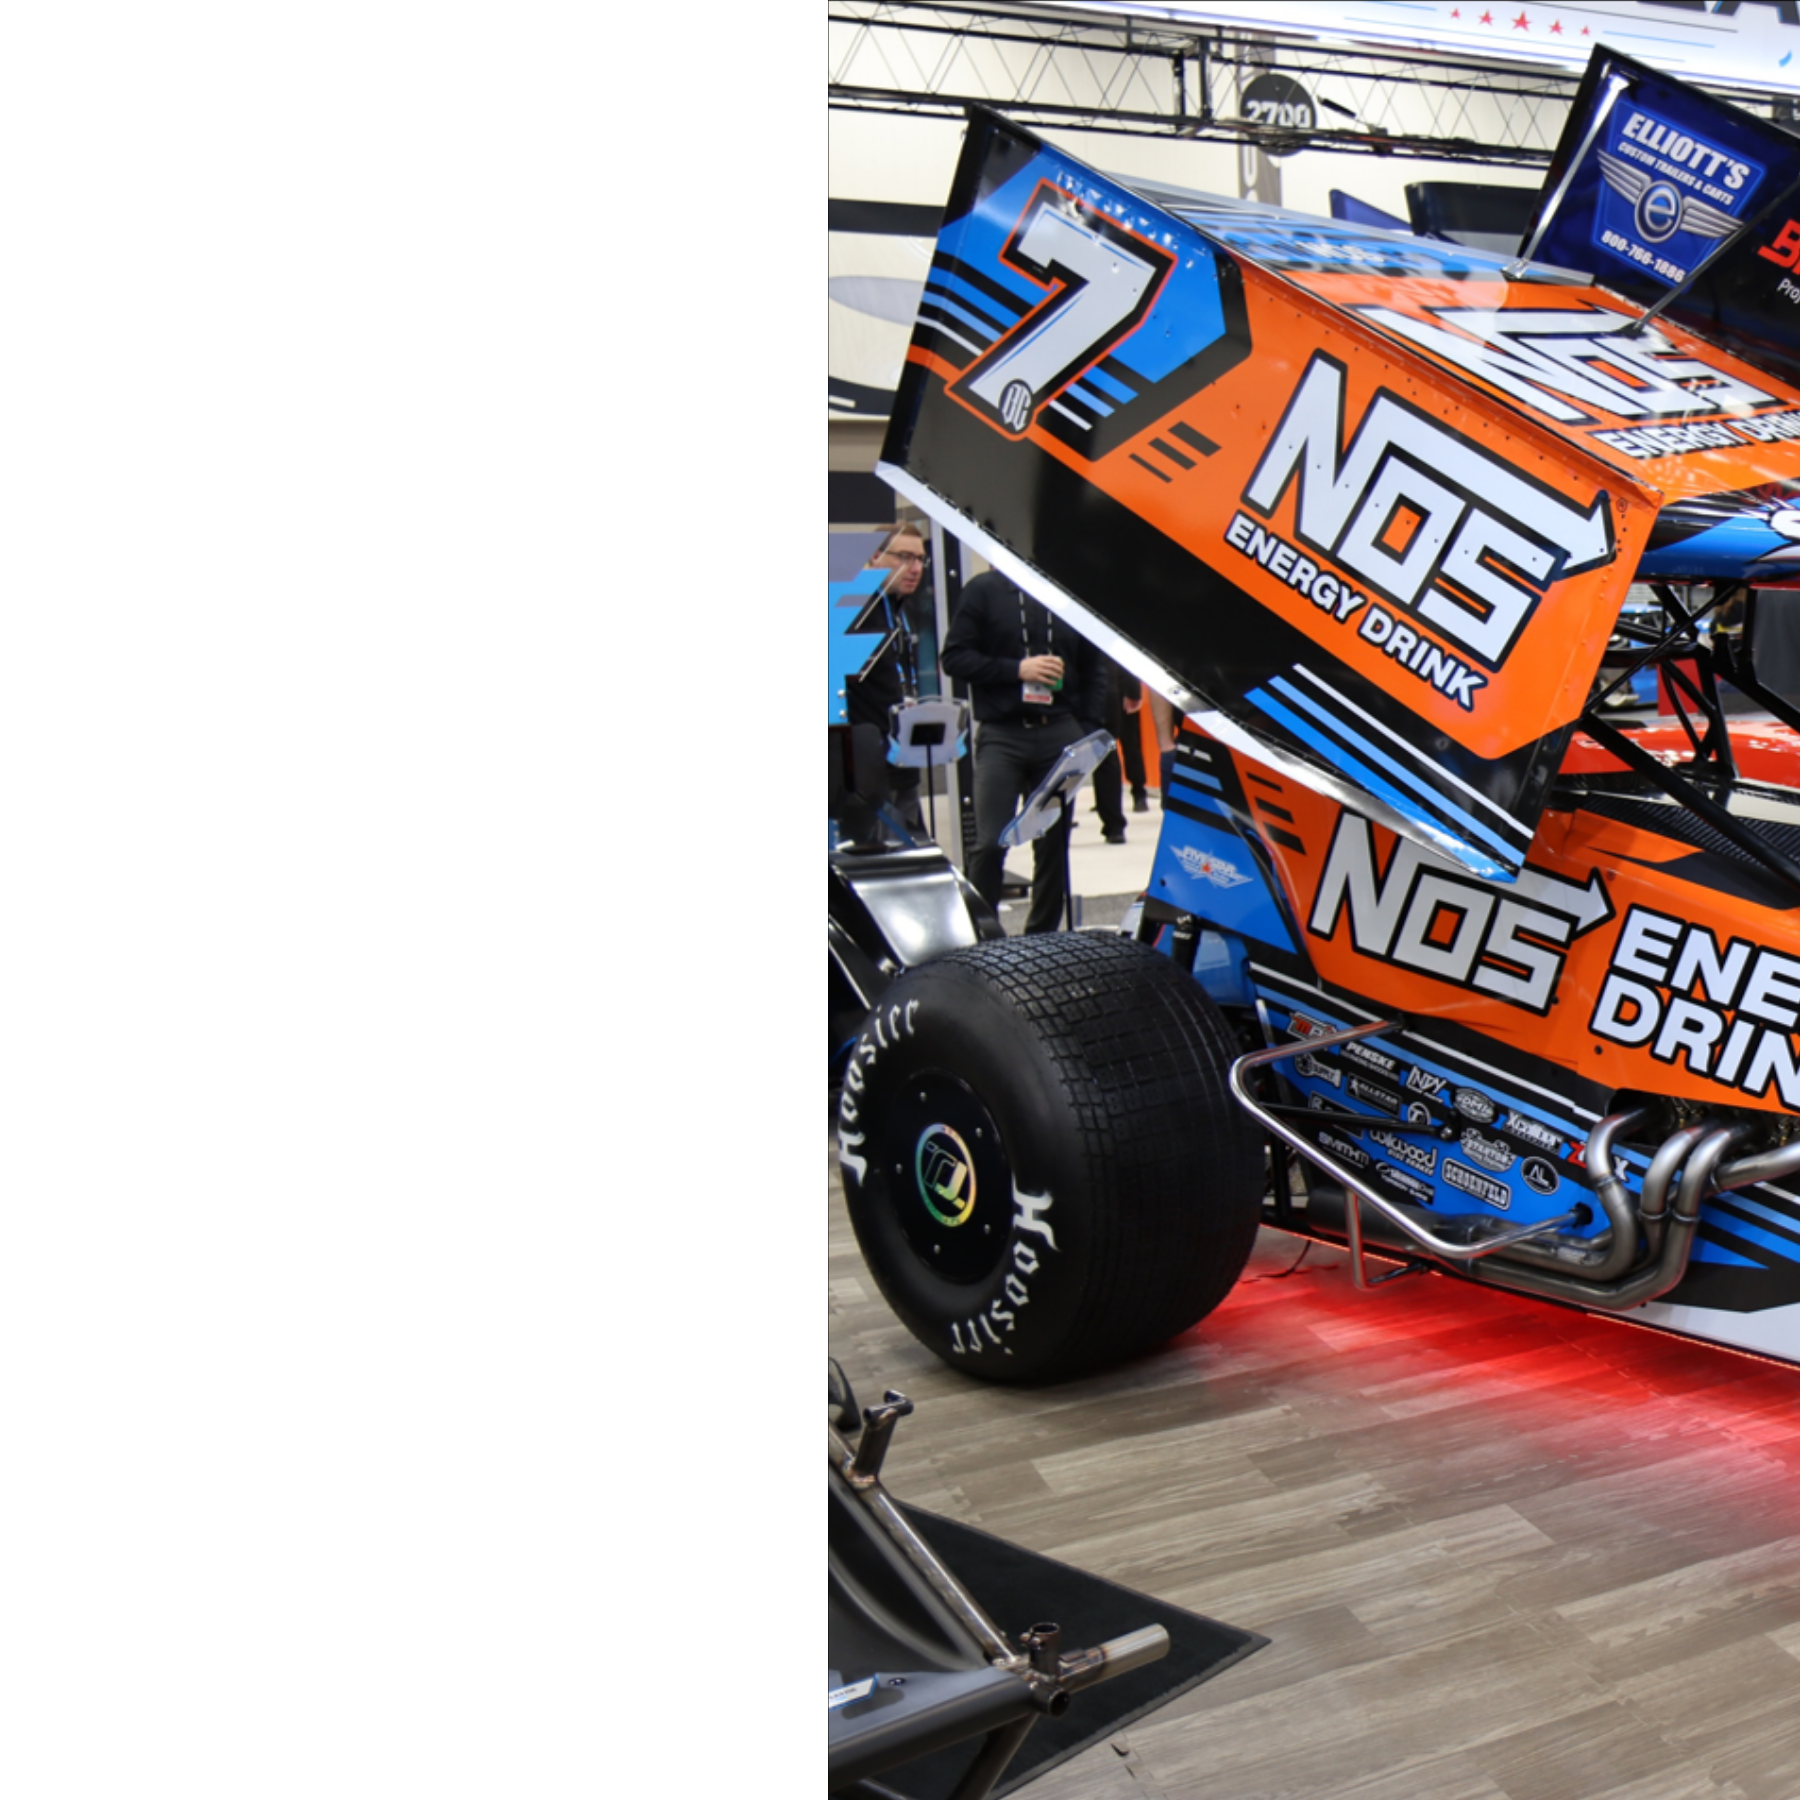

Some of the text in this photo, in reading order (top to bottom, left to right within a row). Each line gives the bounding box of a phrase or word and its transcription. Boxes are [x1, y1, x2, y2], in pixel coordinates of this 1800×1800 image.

[1246, 99, 1312, 129] 2700
[1617, 141, 1656, 167] CUSTOM
[1655, 158, 1698, 188] TRAILERS
[1702, 181, 1735, 205] CARTS
[1622, 112, 1751, 190] ELLIOTT'S
[960, 192, 1166, 422] 7
[1587, 422, 1752, 460] ENERGY
[1241, 350, 1612, 670] NOS
[1224, 510, 1488, 712] ENERGY DRINK
[1309, 810, 1613, 1016] NOS
[838, 998, 920, 1186] Hoosier
[1346, 1041, 1396, 1070] PENSKE
[1444, 1162, 1508, 1206] SCHOENFELD
[950, 1172, 1060, 1355] Hoosier
